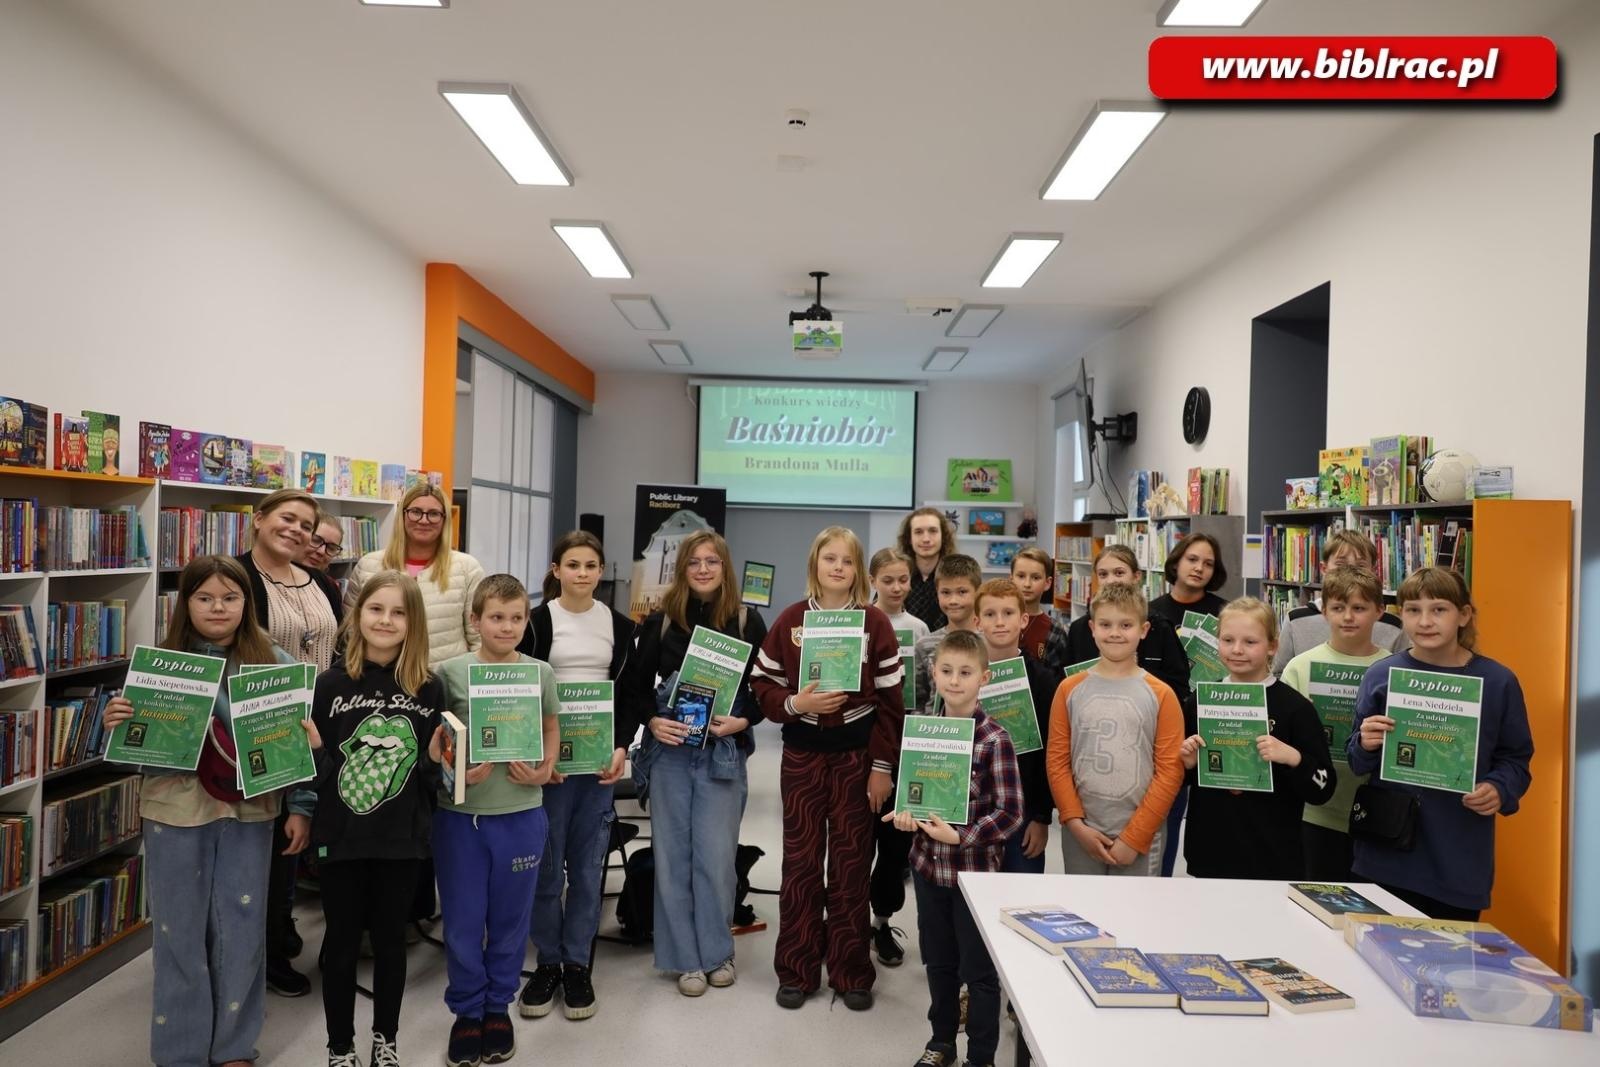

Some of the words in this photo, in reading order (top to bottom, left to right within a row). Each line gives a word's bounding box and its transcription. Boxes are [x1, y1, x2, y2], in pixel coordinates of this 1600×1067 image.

[754, 396, 811, 406] Konkurs
[816, 396, 862, 410] wiedzy
[726, 414, 896, 446] Baśniobór
[744, 457, 820, 471] Brandona
[826, 458, 870, 472] Mulla
[650, 492, 672, 500] Public
[673, 493, 698, 504] Library
[816, 616, 852, 624] Dyplom
[704, 636, 738, 654] Dyplom
[152, 658, 205, 674] Dyplom
[485, 670, 527, 680] Dyplom
[992, 668, 1014, 680] plom
[136, 676, 157, 685] Lidia
[246, 676, 290, 693] Dyplom
[1408, 678, 1462, 694] Dyplom
[564, 688, 601, 698] Dyplom
[1210, 690, 1250, 701] Dyplom
[329, 694, 386, 718] Rolling
[388, 694, 435, 718] Stones
[1402, 698, 1422, 706] Lena
[1425, 700, 1464, 712] Niedziela
[1204, 708, 1229, 717] Patrycja
[918, 723, 960, 734] Dyplom
[1052, 926, 1092, 937] FALA
